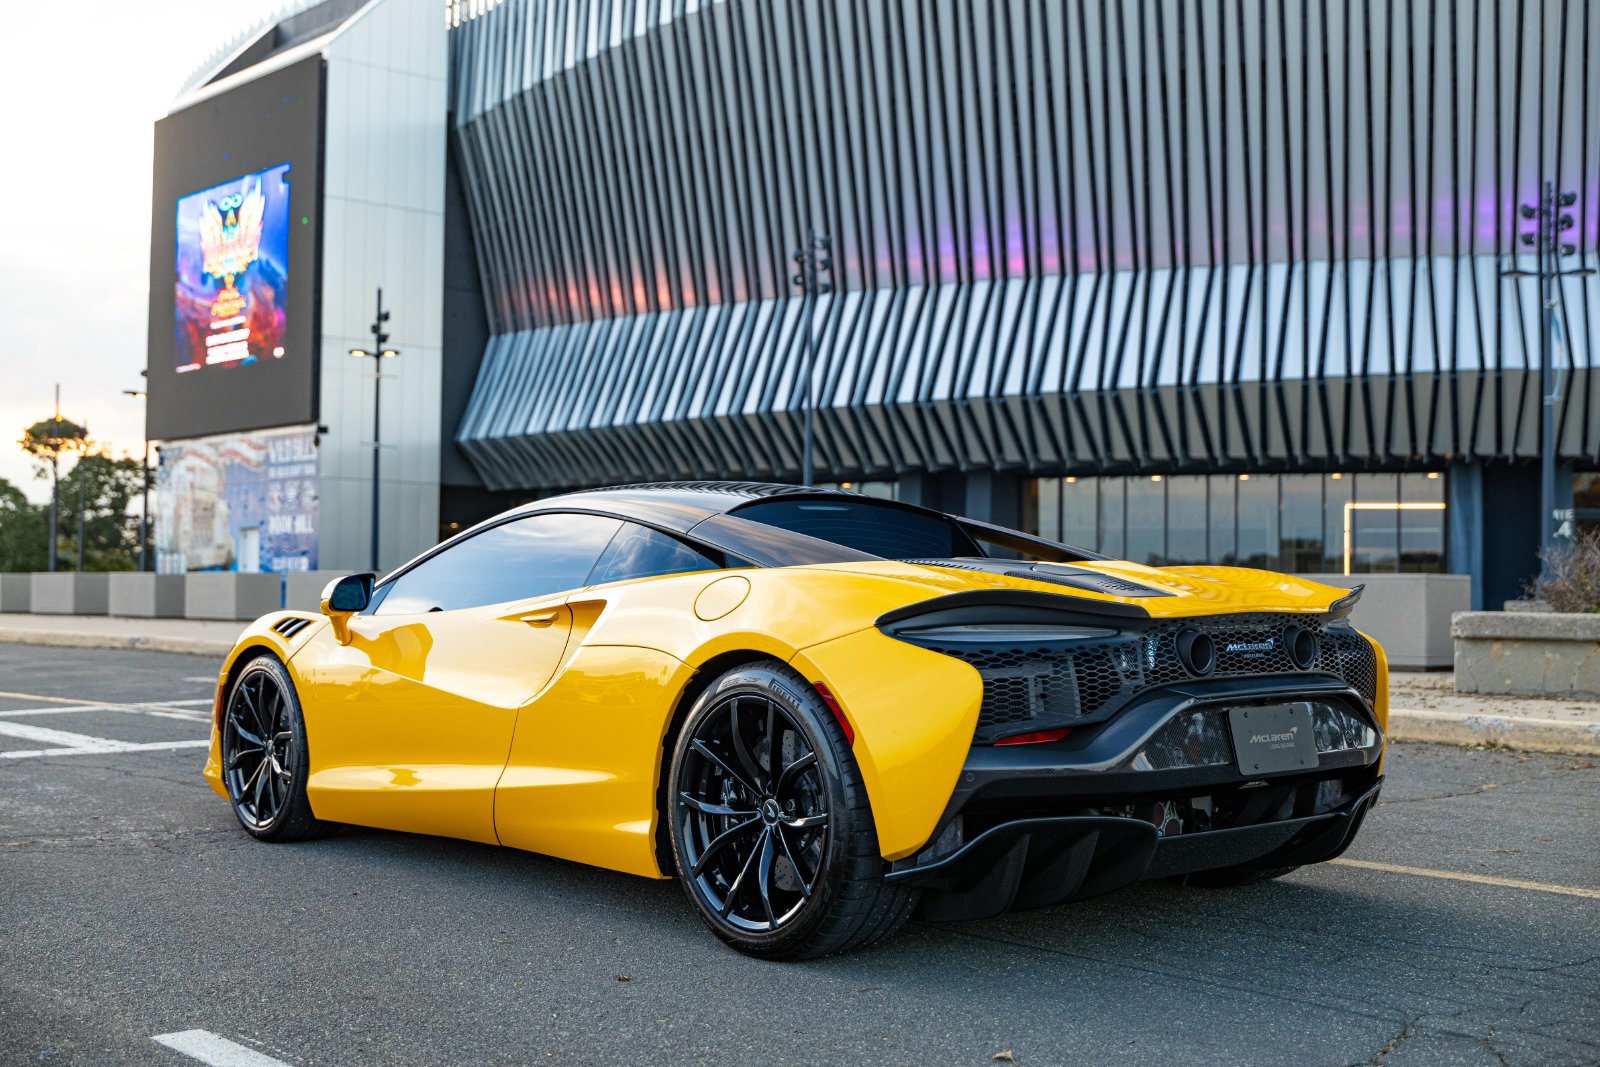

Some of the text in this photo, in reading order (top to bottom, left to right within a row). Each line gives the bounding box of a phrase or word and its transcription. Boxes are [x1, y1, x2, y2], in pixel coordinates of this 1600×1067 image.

[1226, 642, 1273, 651] McLaren
[768, 678, 803, 709] PIRELLI
[1249, 733, 1294, 743] McLaren
